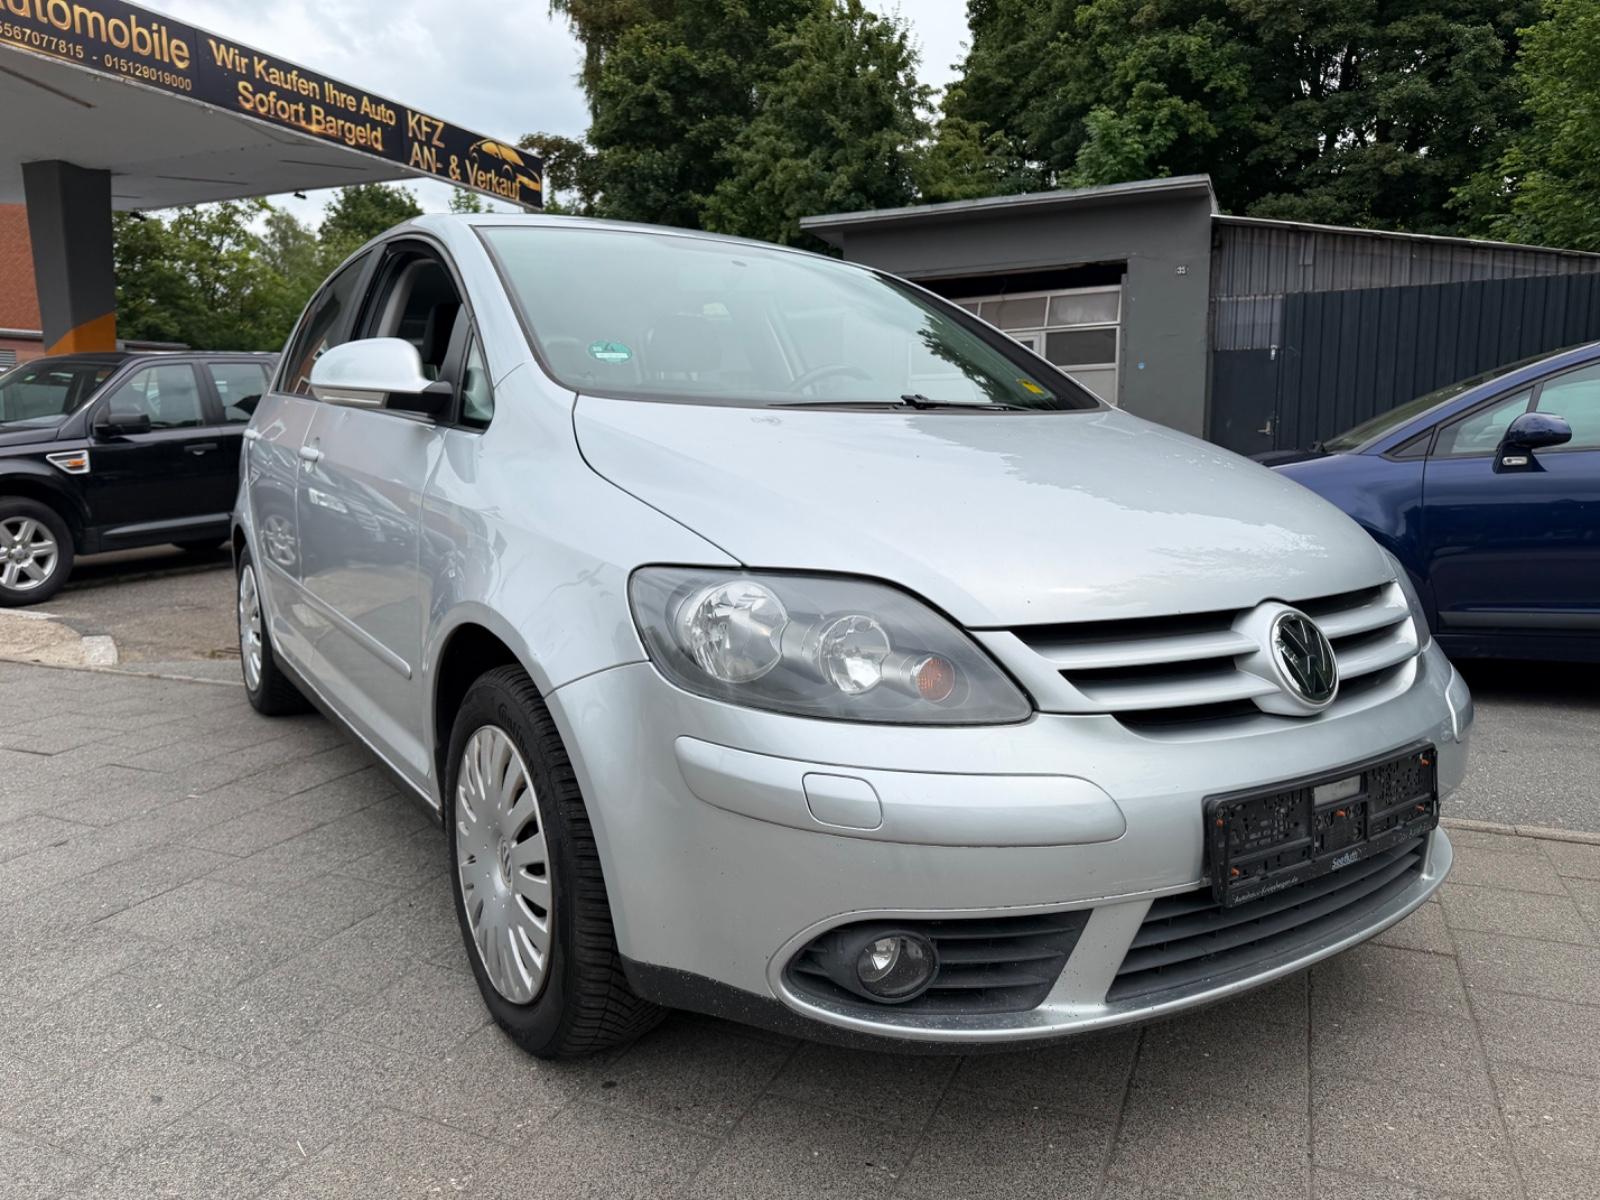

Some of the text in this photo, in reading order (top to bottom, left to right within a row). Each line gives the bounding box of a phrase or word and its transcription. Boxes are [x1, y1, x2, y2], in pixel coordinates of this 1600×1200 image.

[0, 0, 191, 69] utomobile
[0, 21, 84, 59] 567077815
[104, 54, 193, 92] 015129019000
[208, 39, 396, 126] Wir Kaufen Ihre Auto
[237, 81, 384, 151] Sofort Bargeld
[407, 111, 445, 148] KFZ
[409, 143, 520, 201] AN- & Verkauf
